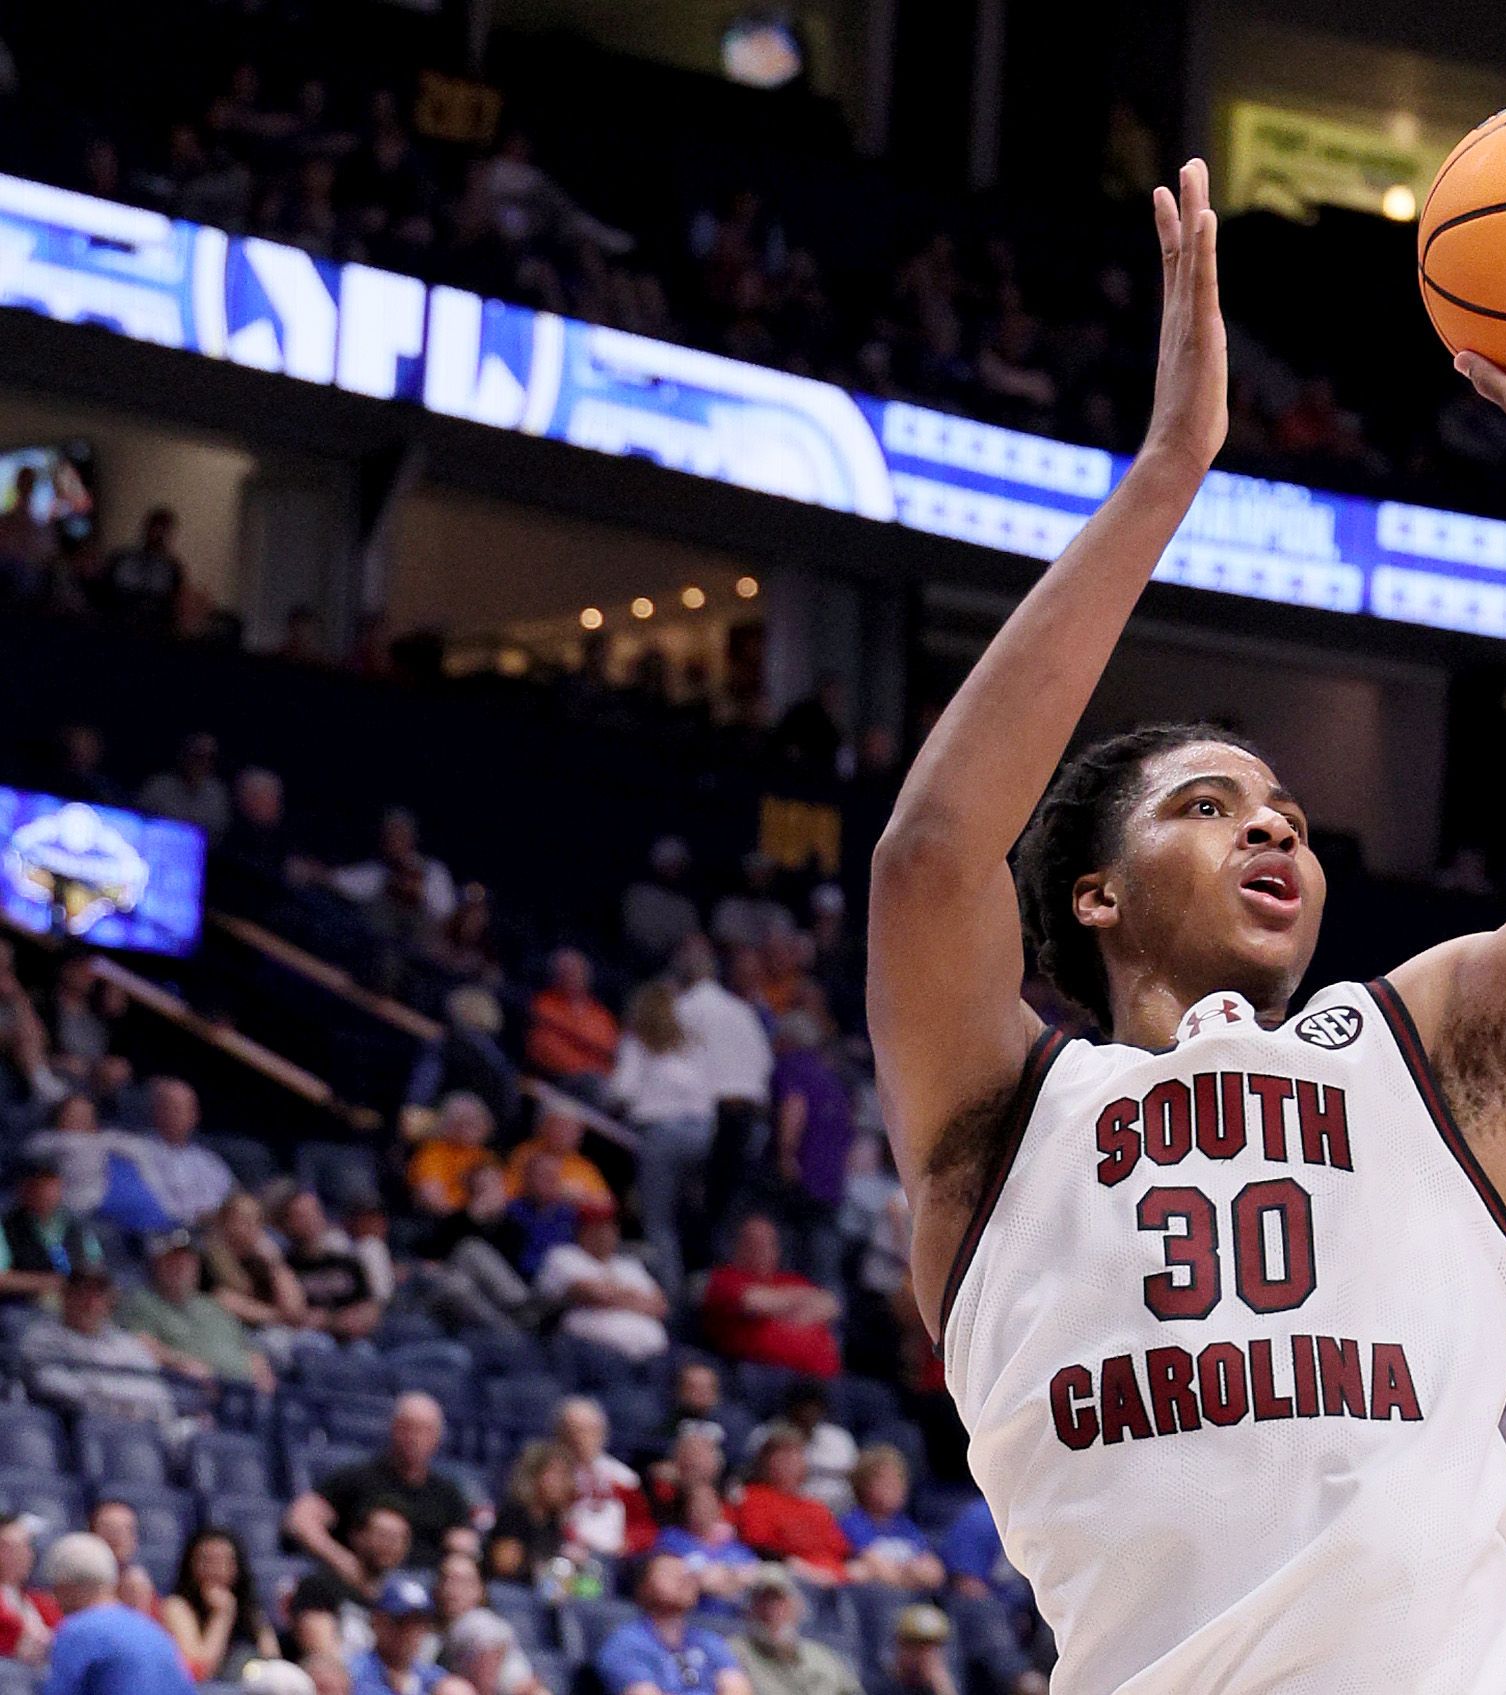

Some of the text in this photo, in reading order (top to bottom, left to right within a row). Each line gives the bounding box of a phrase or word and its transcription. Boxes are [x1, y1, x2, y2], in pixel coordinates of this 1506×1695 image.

[1300, 1007, 1360, 1047] SEC
[1096, 1071, 1354, 1188] SOUTH
[1137, 1177, 1317, 1321] 30
[1049, 1334, 1424, 1451] CAROLINA
